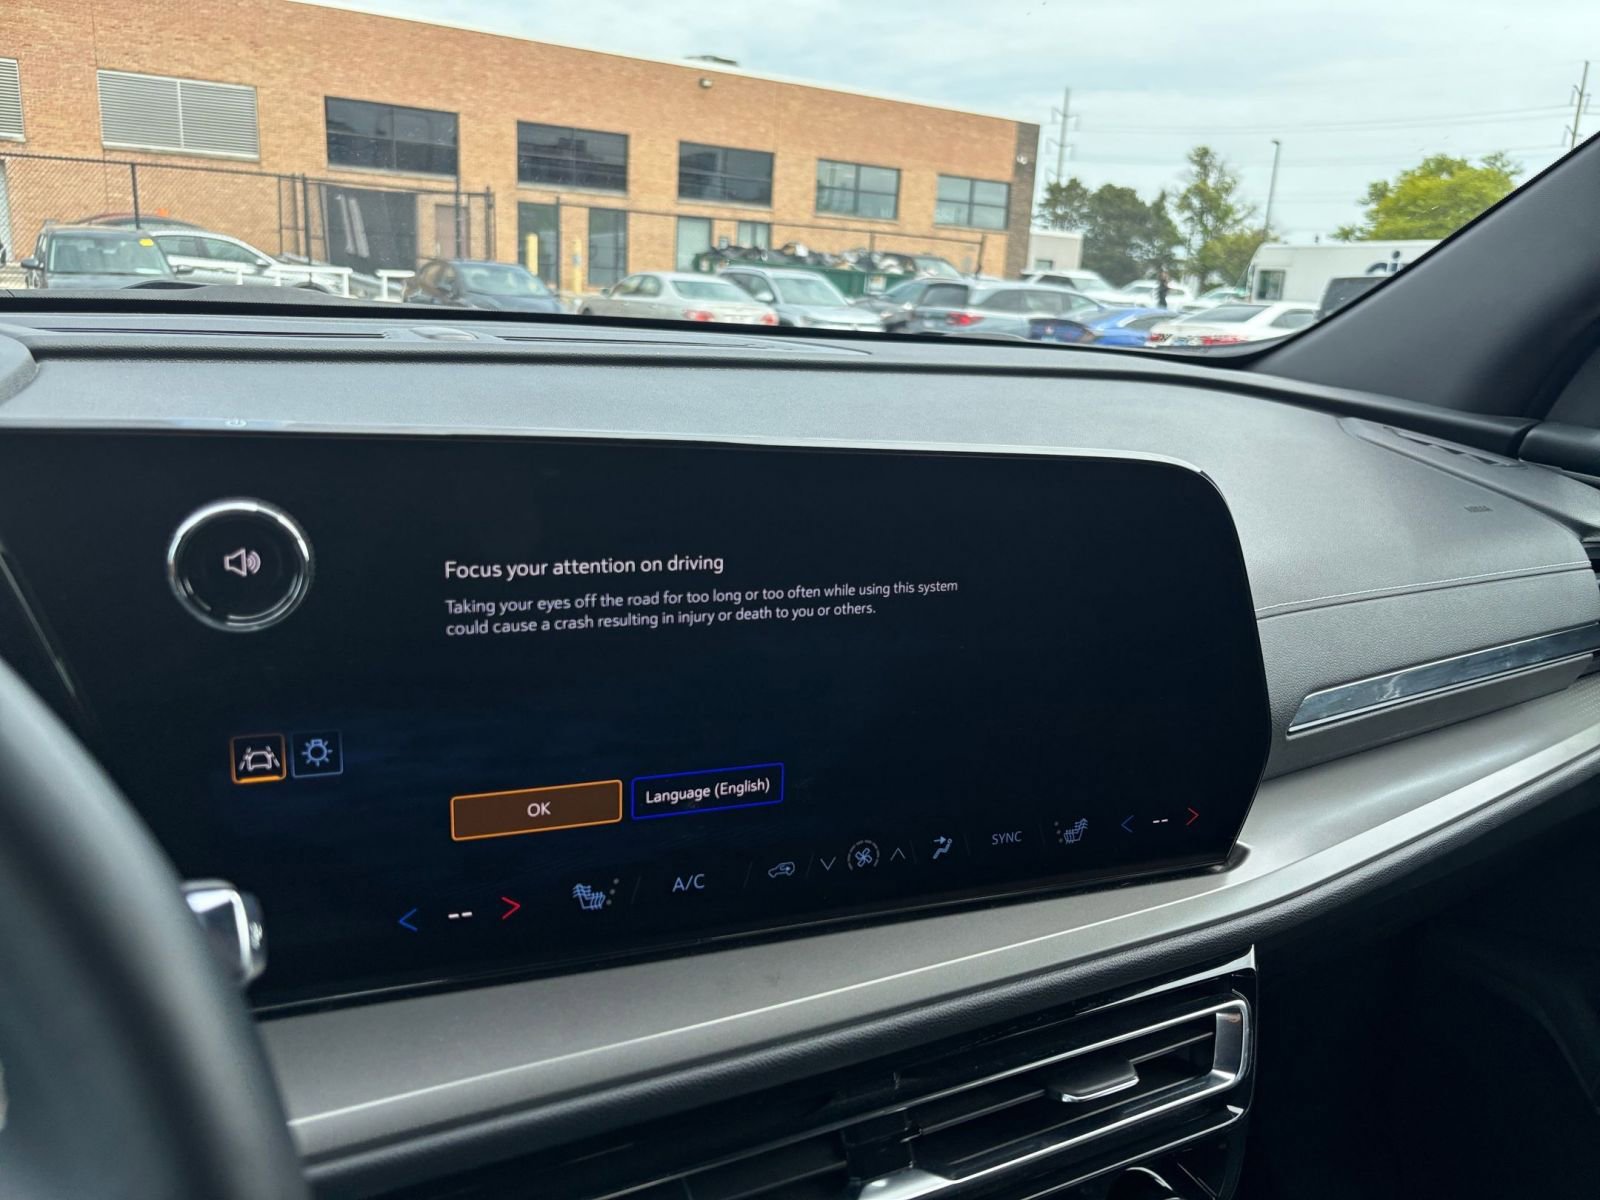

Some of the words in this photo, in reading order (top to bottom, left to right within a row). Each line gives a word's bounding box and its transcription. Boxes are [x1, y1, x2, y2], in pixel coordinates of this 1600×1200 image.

[444, 560, 503, 579] Focus
[505, 562, 549, 582] your
[552, 557, 636, 576] attention
[639, 559, 663, 573] on
[666, 553, 724, 575] driving
[444, 598, 496, 617] Taking
[499, 599, 534, 616] your
[536, 598, 572, 612] eyes
[574, 592, 598, 609] off
[599, 593, 624, 608] the
[627, 591, 660, 606] road
[662, 589, 684, 605] for
[686, 591, 710, 604] too
[712, 588, 742, 605] long
[744, 590, 760, 601] or
[762, 588, 785, 600] too
[787, 584, 821, 599] often
[823, 583, 856, 597] while
[858, 583, 891, 598] using
[893, 581, 915, 594] this
[917, 581, 958, 596] system
[445, 619, 489, 636] could
[492, 620, 538, 634] cause
[540, 620, 551, 631] a
[553, 614, 594, 631] crash
[597, 612, 659, 629] resulting
[661, 611, 675, 624] in
[677, 610, 716, 627] injury
[717, 611, 733, 622] or
[735, 606, 773, 621] death
[775, 607, 790, 619] to
[791, 607, 815, 622] you
[817, 606, 831, 617] or
[833, 602, 876, 616] others.
[645, 787, 711, 805] Language
[714, 777, 771, 799] (English)
[526, 801, 552, 819] OK
[991, 830, 1022, 846] SYNC
[671, 873, 705, 893] A/C
